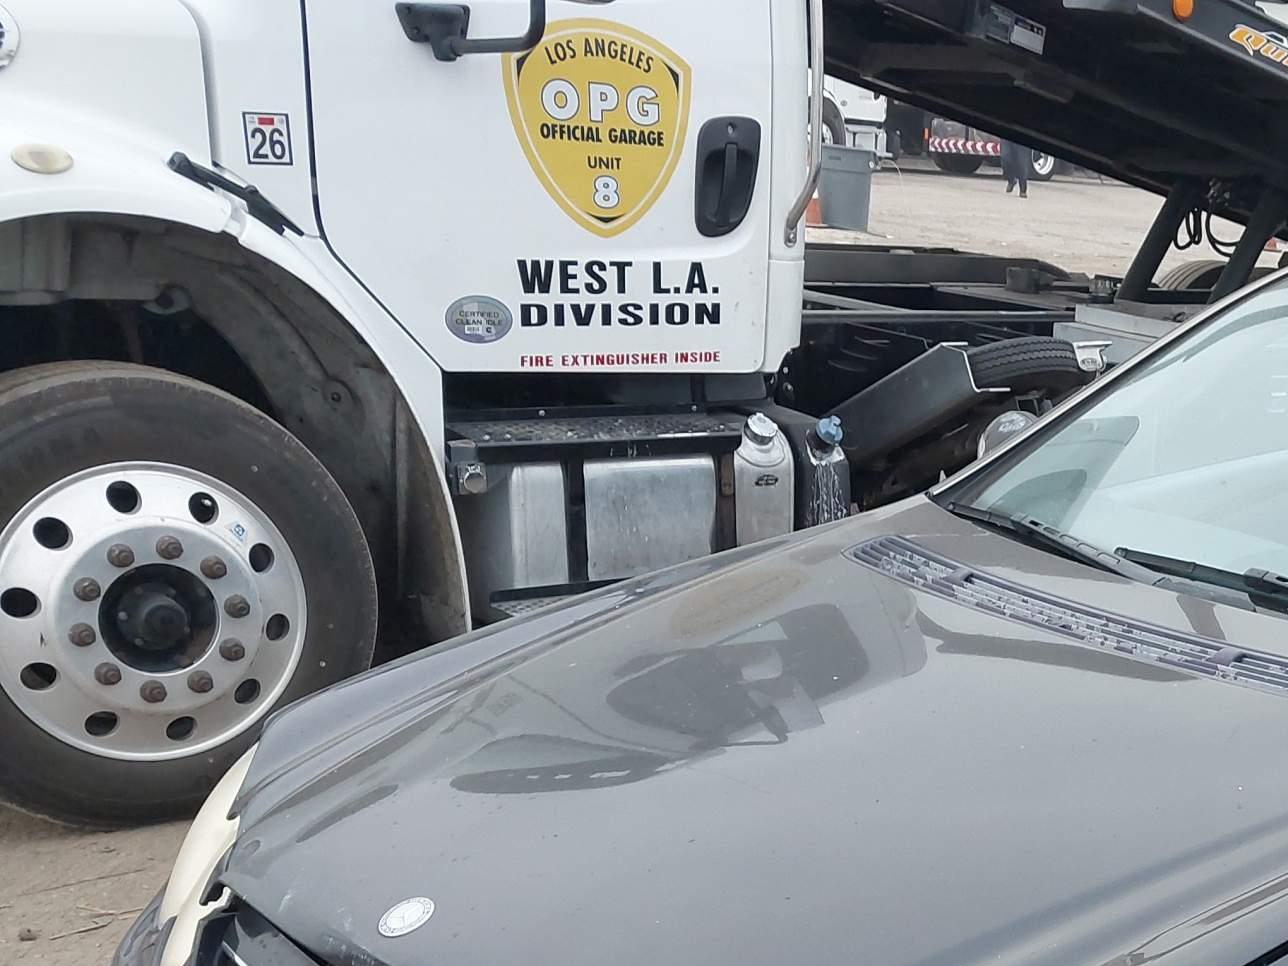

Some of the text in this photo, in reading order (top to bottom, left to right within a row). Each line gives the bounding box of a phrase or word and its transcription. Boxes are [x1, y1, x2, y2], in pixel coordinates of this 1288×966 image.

[545, 37, 654, 73] LOS ANGELES
[541, 78, 660, 126] OPG
[251, 127, 286, 160] 26
[540, 123, 664, 147] OFFICIAL GARAGE
[588, 155, 621, 170] UNIT
[593, 175, 620, 209] 8
[517, 259, 720, 294] WEST L.A.
[520, 302, 721, 327] DIVISION
[520, 351, 721, 368] FIRE EXTINGUISHER INSIDE
